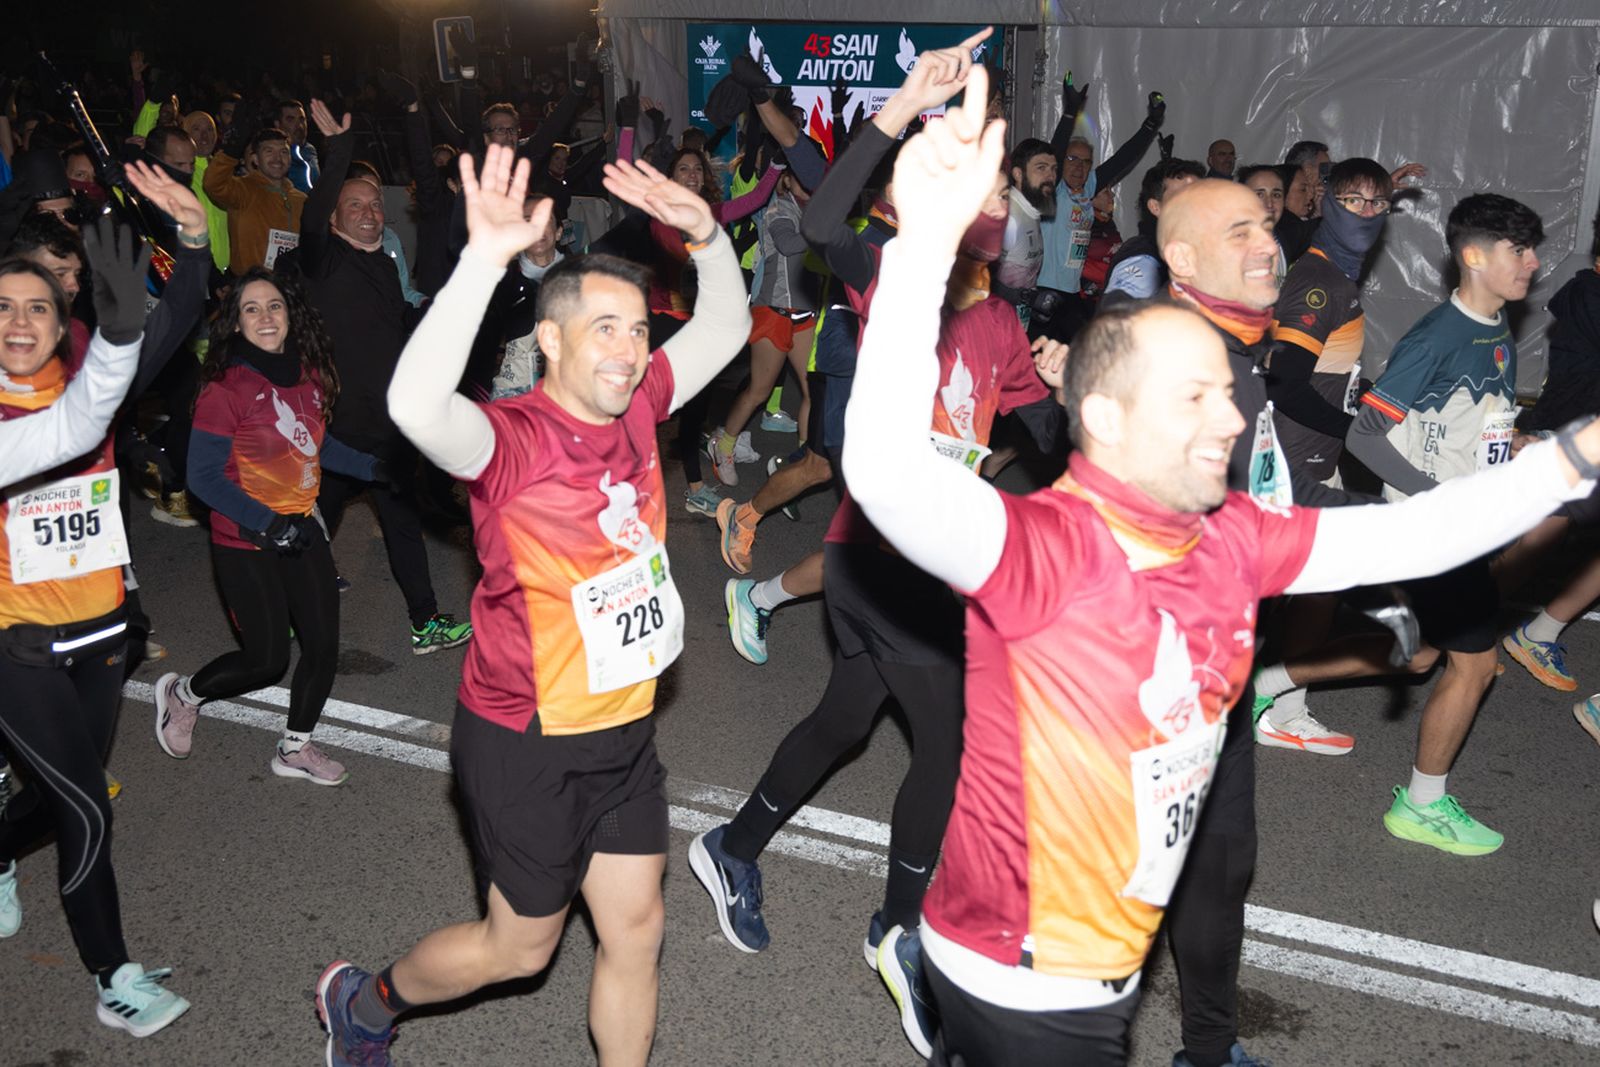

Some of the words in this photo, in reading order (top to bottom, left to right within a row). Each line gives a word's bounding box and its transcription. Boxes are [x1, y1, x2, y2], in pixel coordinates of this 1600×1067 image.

[803, 33, 831, 58] 43
[831, 33, 879, 56] SAN
[797, 53, 875, 81] ANTÓN
[293, 427, 309, 447] 43
[1420, 420, 1447, 440] TEN
[1481, 432, 1497, 441] SAN
[33, 490, 69, 502] NOCHE
[69, 488, 81, 498] DE
[20, 504, 43, 517] SAN
[33, 508, 101, 547] 5195
[616, 518, 644, 546] 43
[602, 580, 633, 598] NOCHE
[616, 595, 664, 647] 228
[1162, 697, 1195, 734] 43
